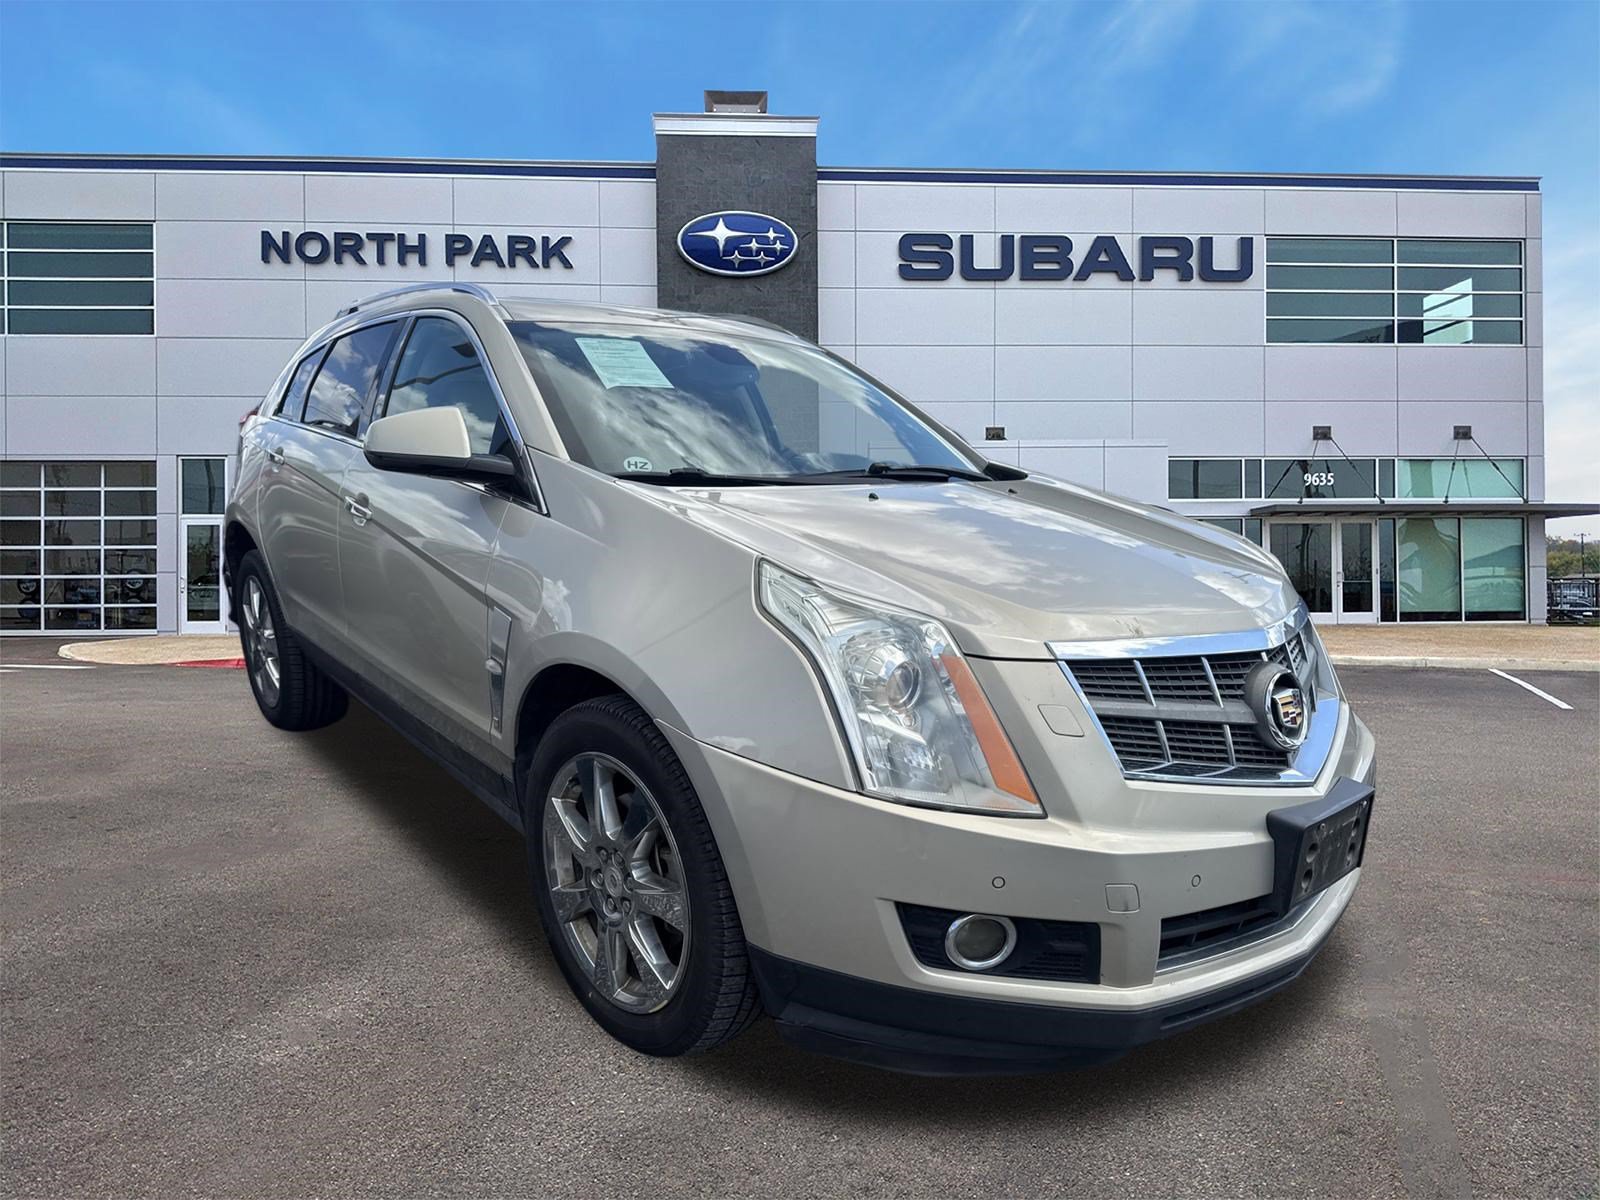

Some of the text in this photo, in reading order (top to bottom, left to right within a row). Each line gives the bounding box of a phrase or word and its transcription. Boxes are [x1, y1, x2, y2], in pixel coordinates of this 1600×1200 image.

[261, 230, 574, 269] NORTH PARK
[898, 233, 1254, 282] SUBARU
[627, 460, 649, 470] HZ
[1303, 472, 1335, 486] 9635
